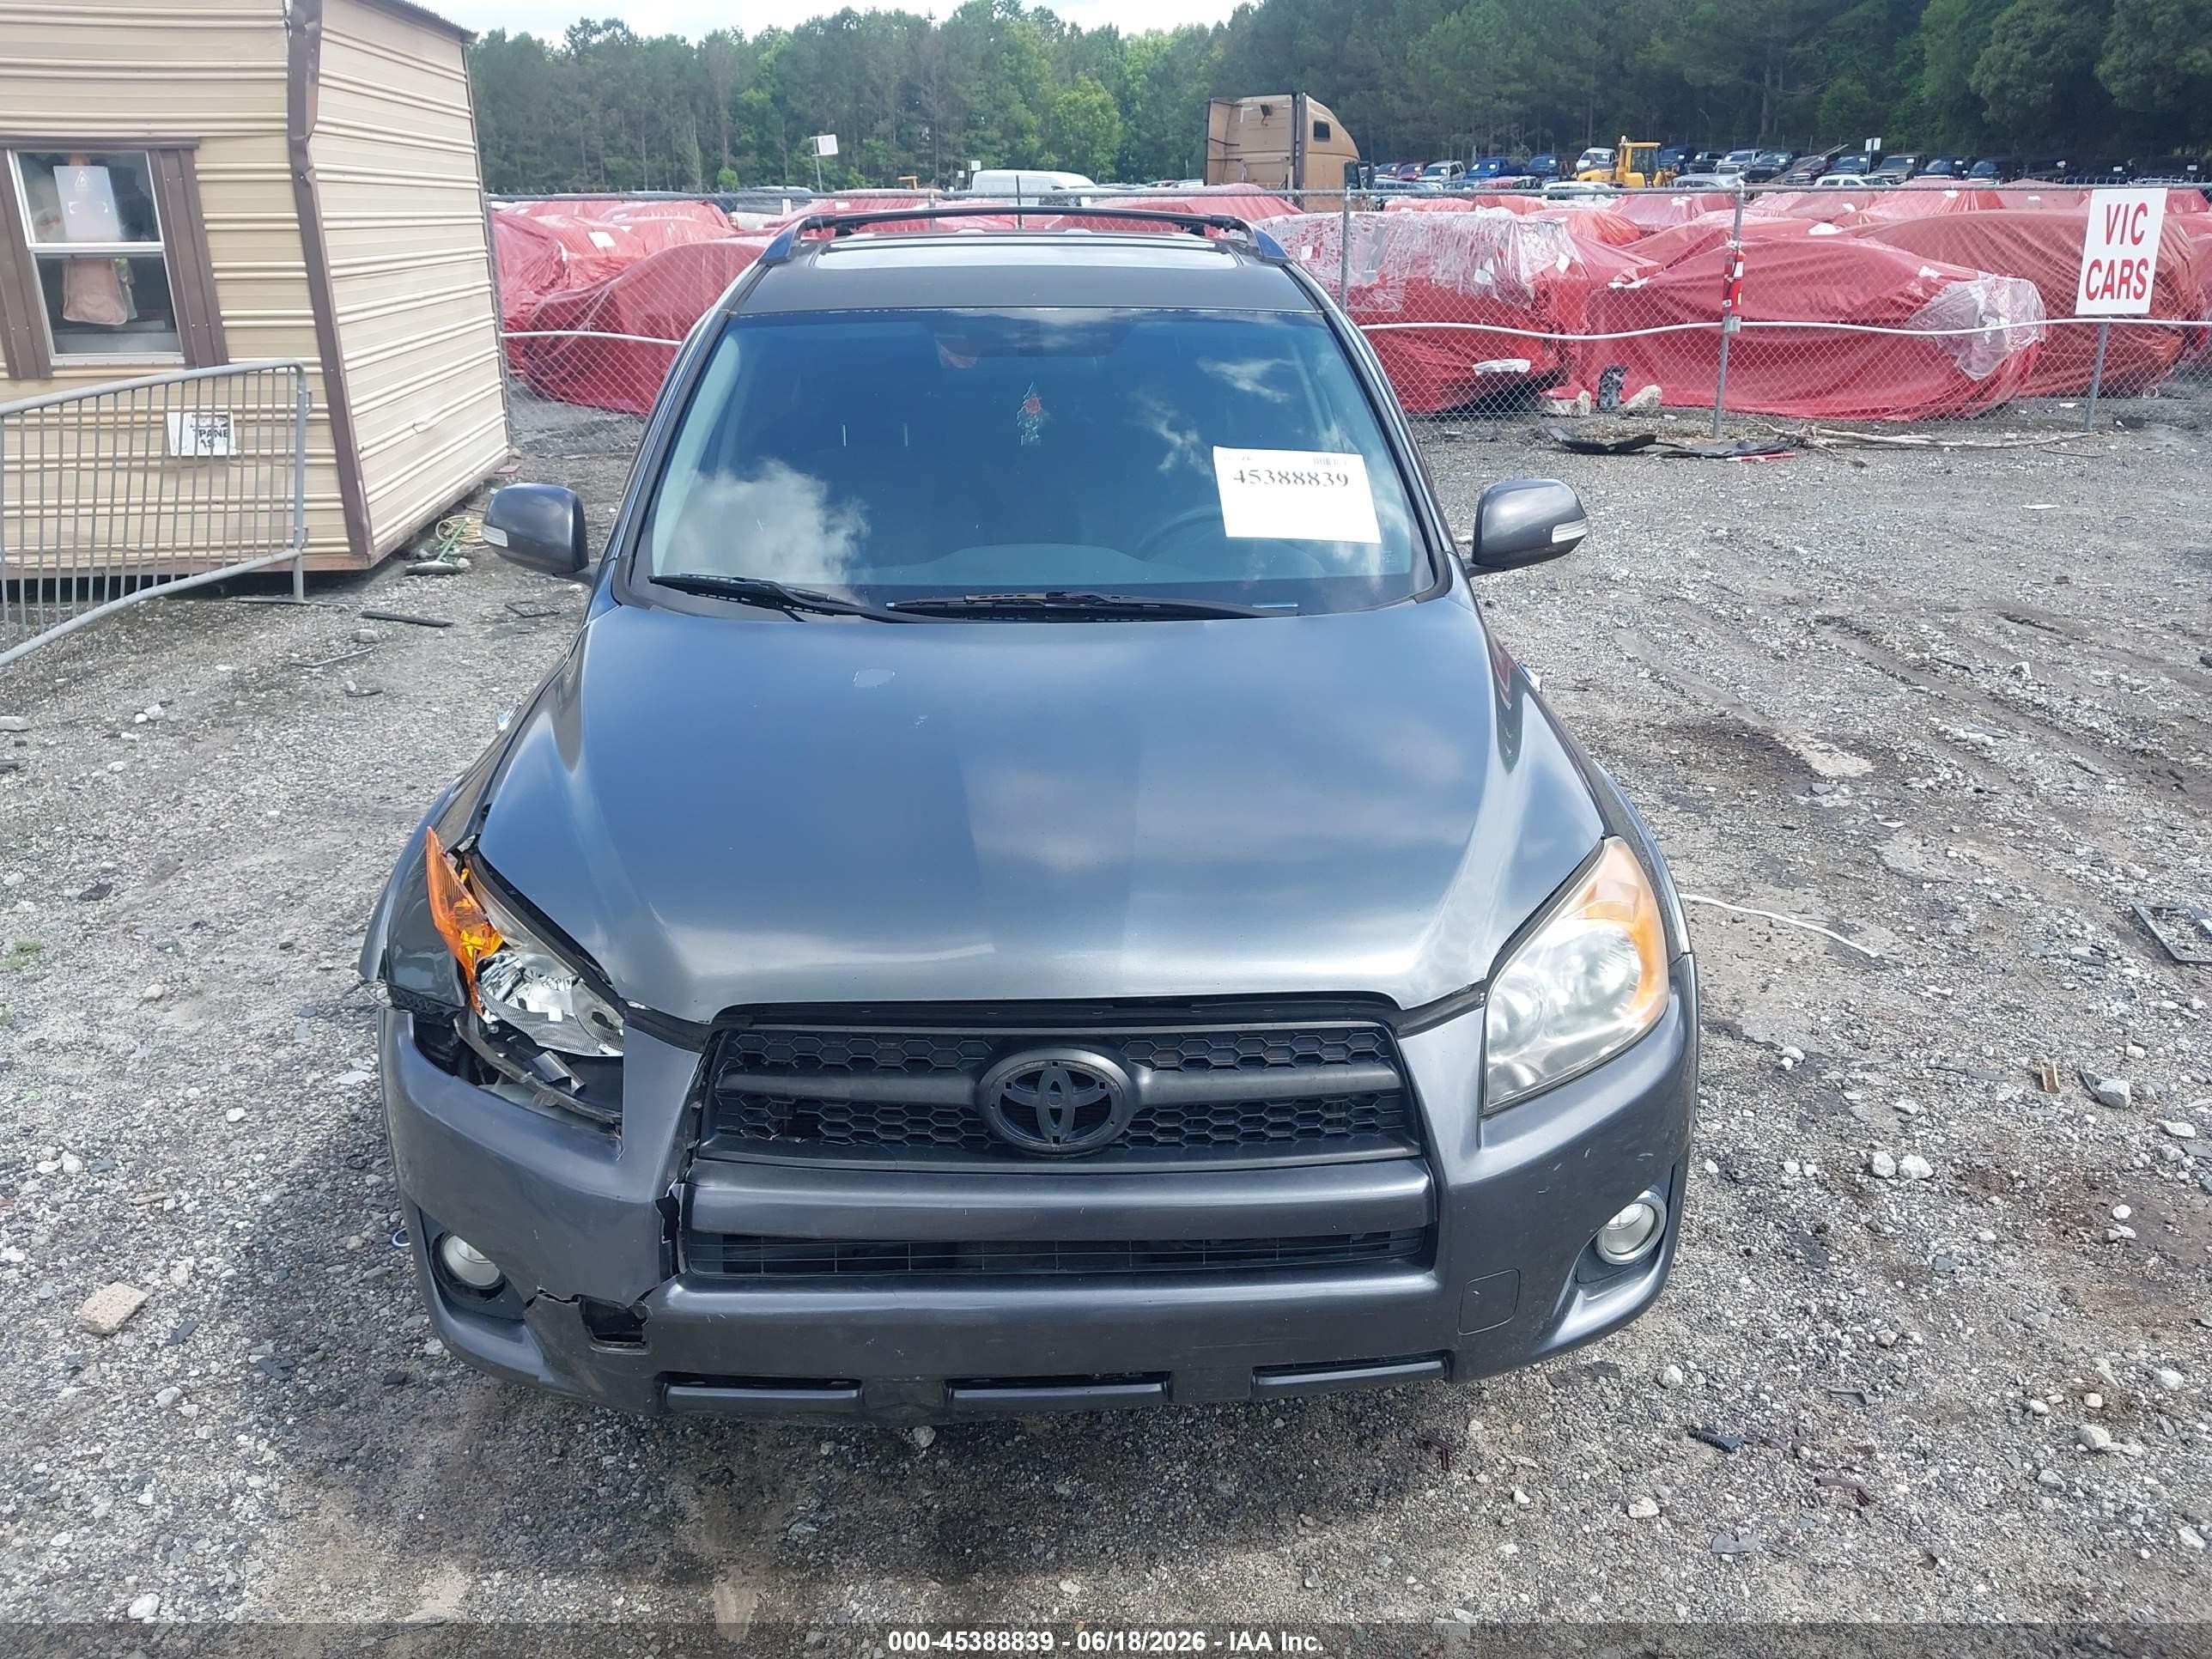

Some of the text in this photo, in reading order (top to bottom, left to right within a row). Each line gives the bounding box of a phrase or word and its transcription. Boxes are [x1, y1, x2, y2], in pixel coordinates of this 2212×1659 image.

[2106, 203, 2148, 246] VIC
[2086, 258, 2149, 301] CARS
[1233, 469, 1349, 488] 45388839
